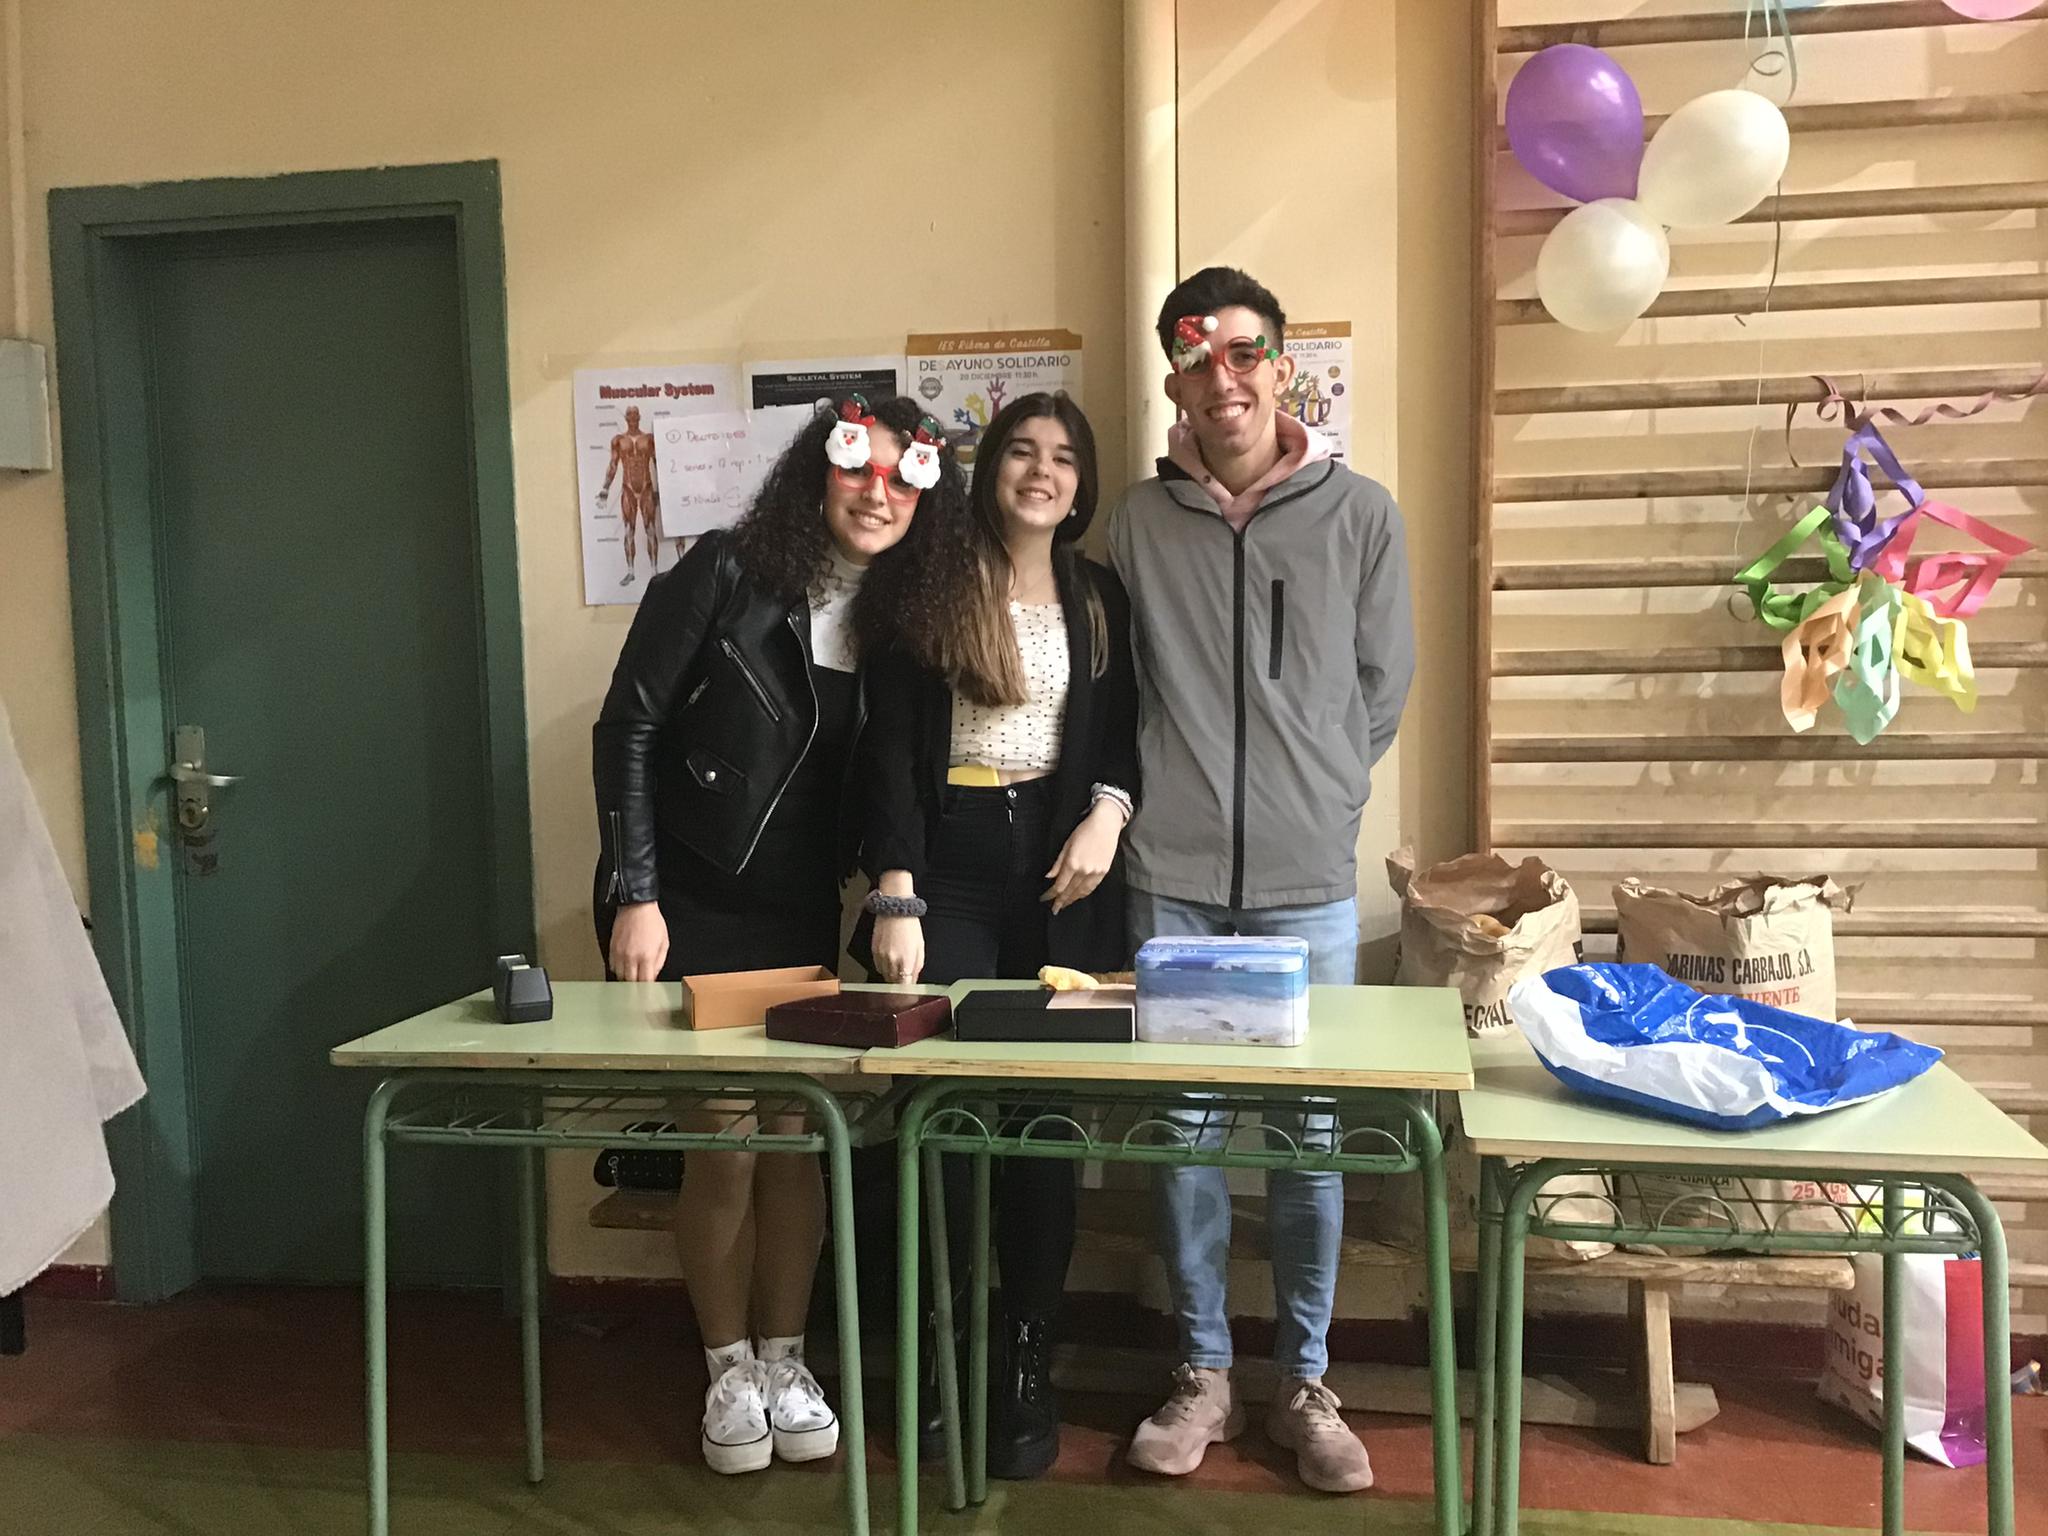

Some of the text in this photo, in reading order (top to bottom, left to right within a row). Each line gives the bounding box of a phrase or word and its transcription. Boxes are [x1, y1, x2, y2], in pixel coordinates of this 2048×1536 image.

[937, 341, 954, 351] IES
[994, 339, 1006, 349] de
[1009, 337, 1051, 348] Castilla
[1286, 341, 1342, 351] SOLIDARIO
[919, 354, 1071, 372] DESAYUNO SOLIDARIO
[599, 382, 715, 399] Muscular System
[1792, 1183, 1815, 1200] 25
[1834, 1296, 1881, 1338] uda
[1832, 1331, 1884, 1381] miga
